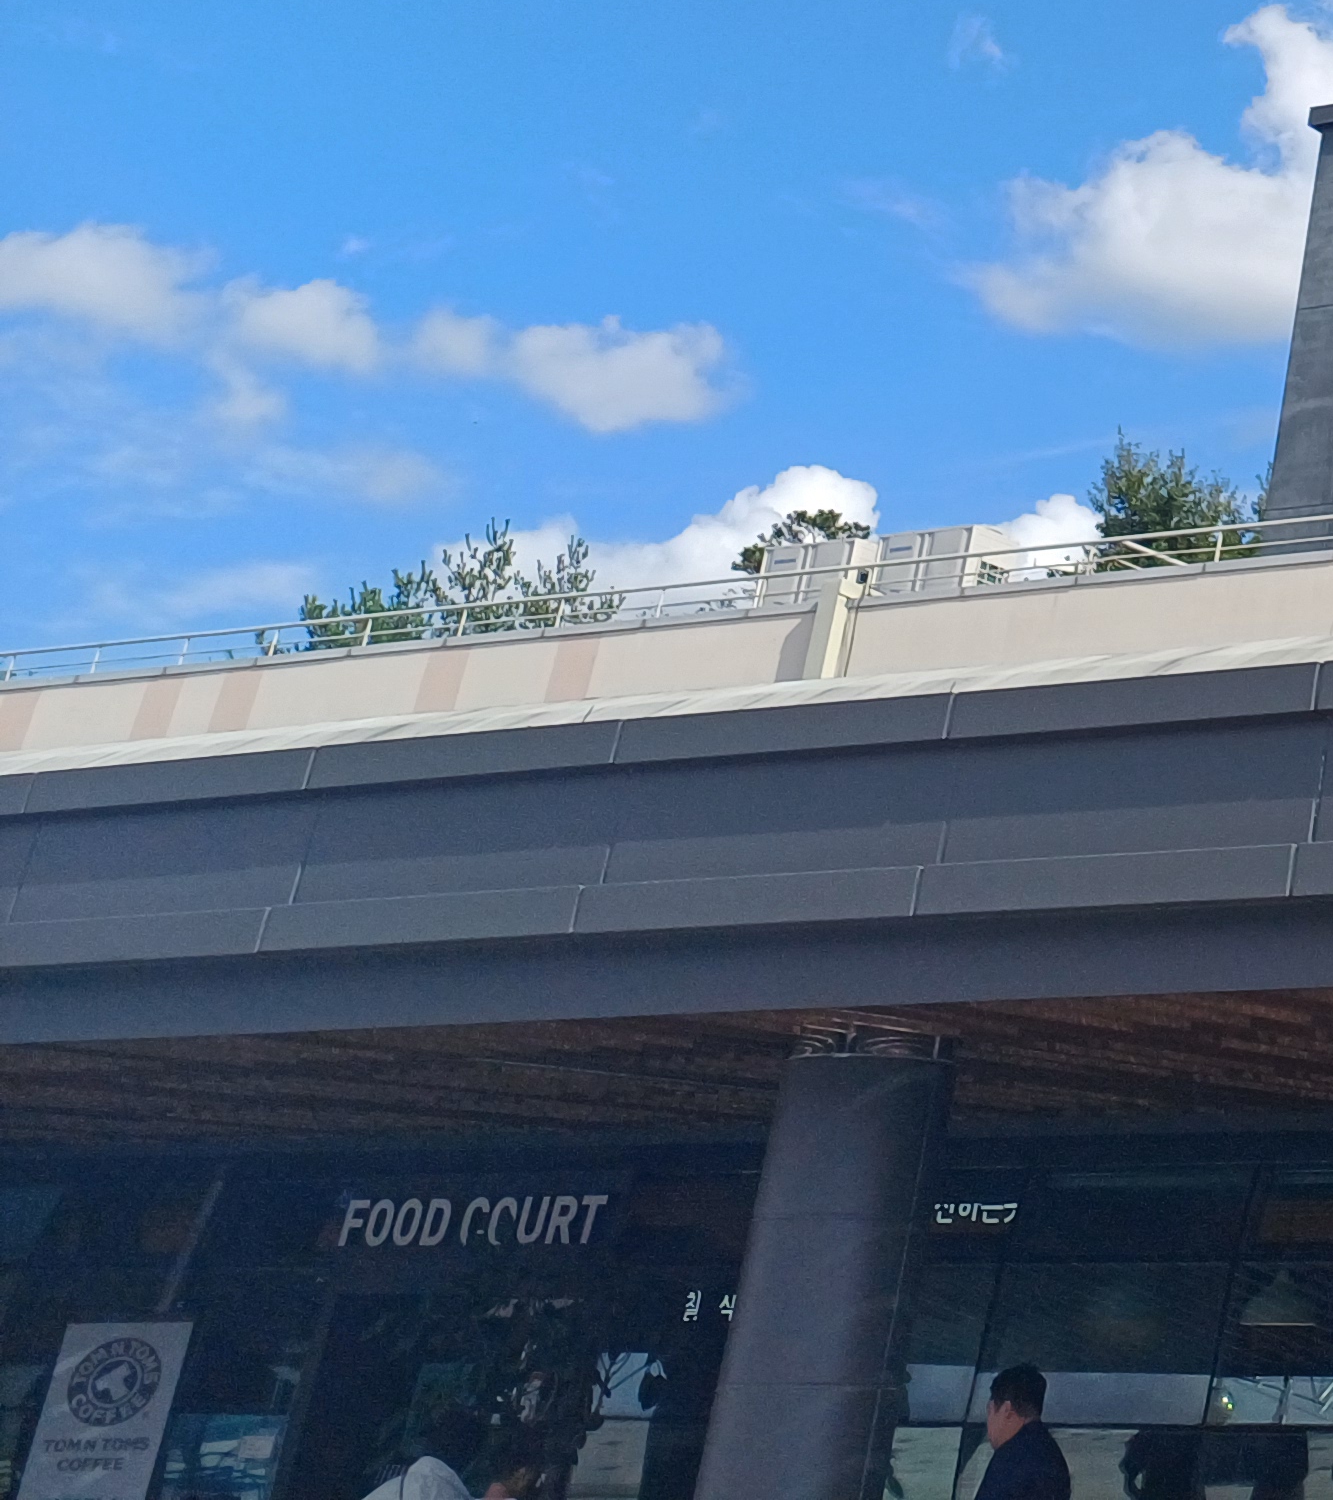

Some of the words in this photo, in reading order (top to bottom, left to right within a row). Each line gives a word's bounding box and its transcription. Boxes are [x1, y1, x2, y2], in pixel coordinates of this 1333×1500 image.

[338, 1198, 451, 1246] FOOD
[460, 1195, 608, 1246] COURT
[71, 1392, 149, 1426] COFFEE
[57, 1457, 125, 1472] COFFEE
